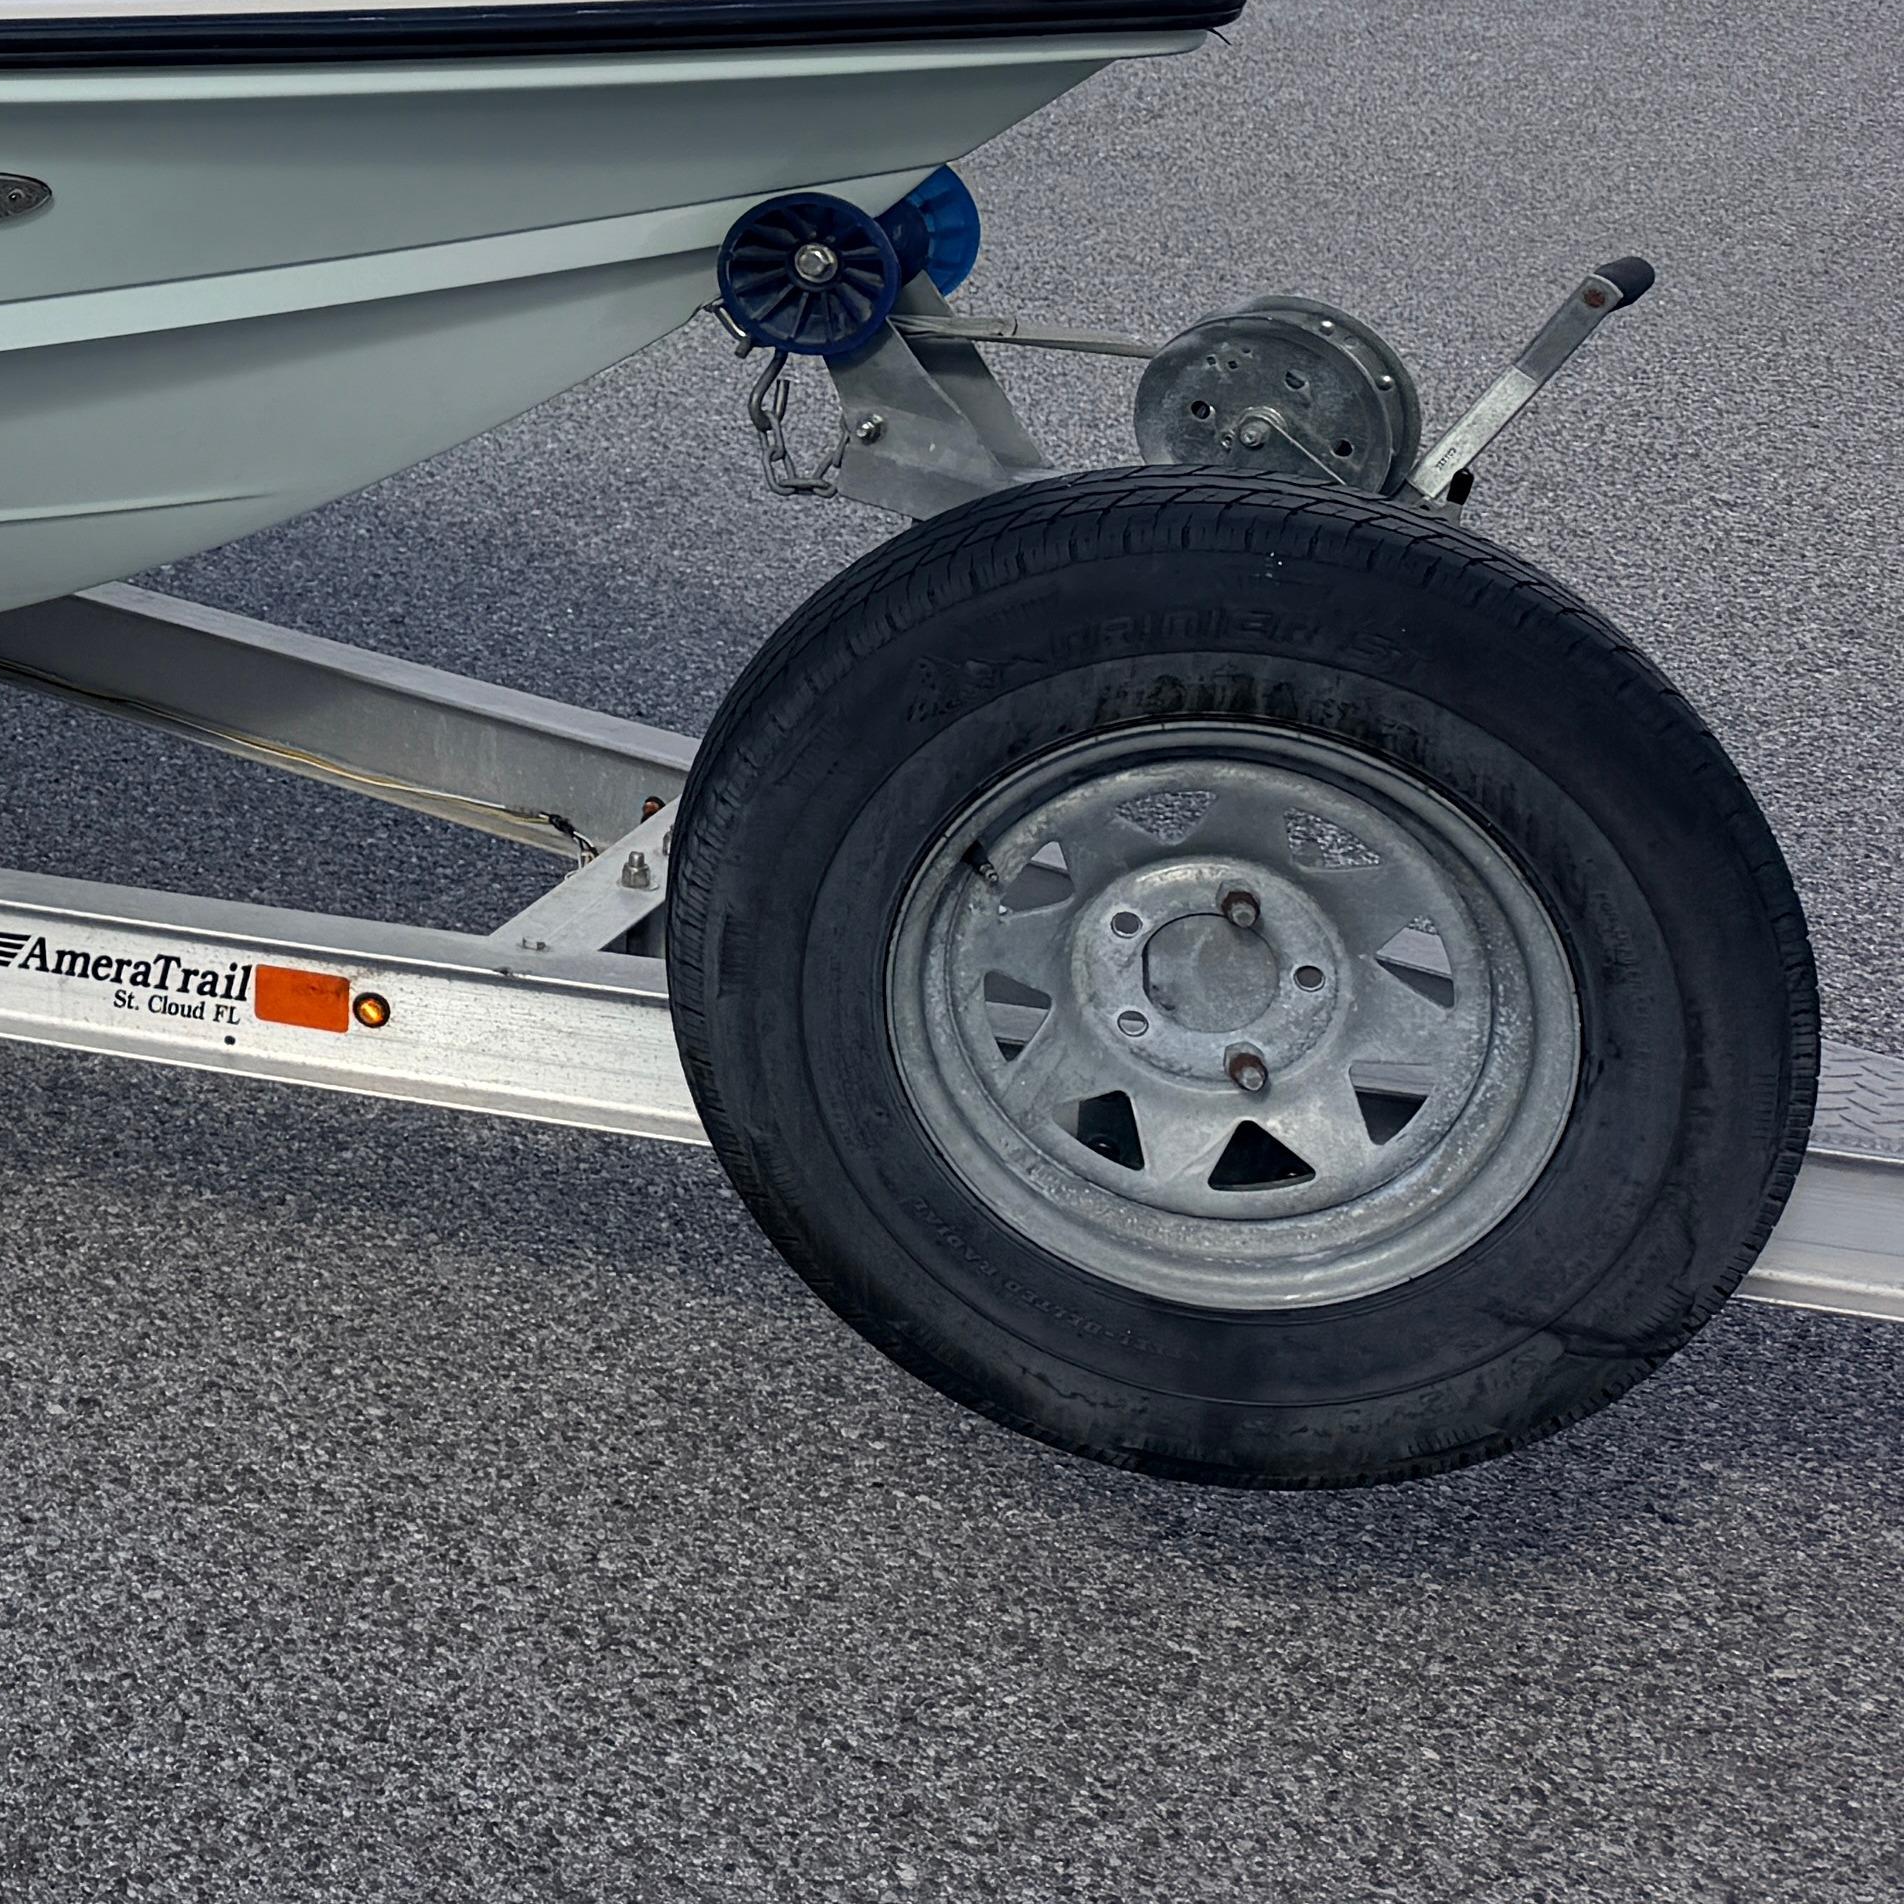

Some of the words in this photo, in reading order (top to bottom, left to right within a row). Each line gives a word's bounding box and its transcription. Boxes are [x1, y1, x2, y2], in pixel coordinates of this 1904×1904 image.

[18, 937, 253, 1002] AmeraTrail
[113, 988, 139, 1011] St.
[147, 993, 206, 1022] Cloud
[213, 1004, 241, 1026] FL
